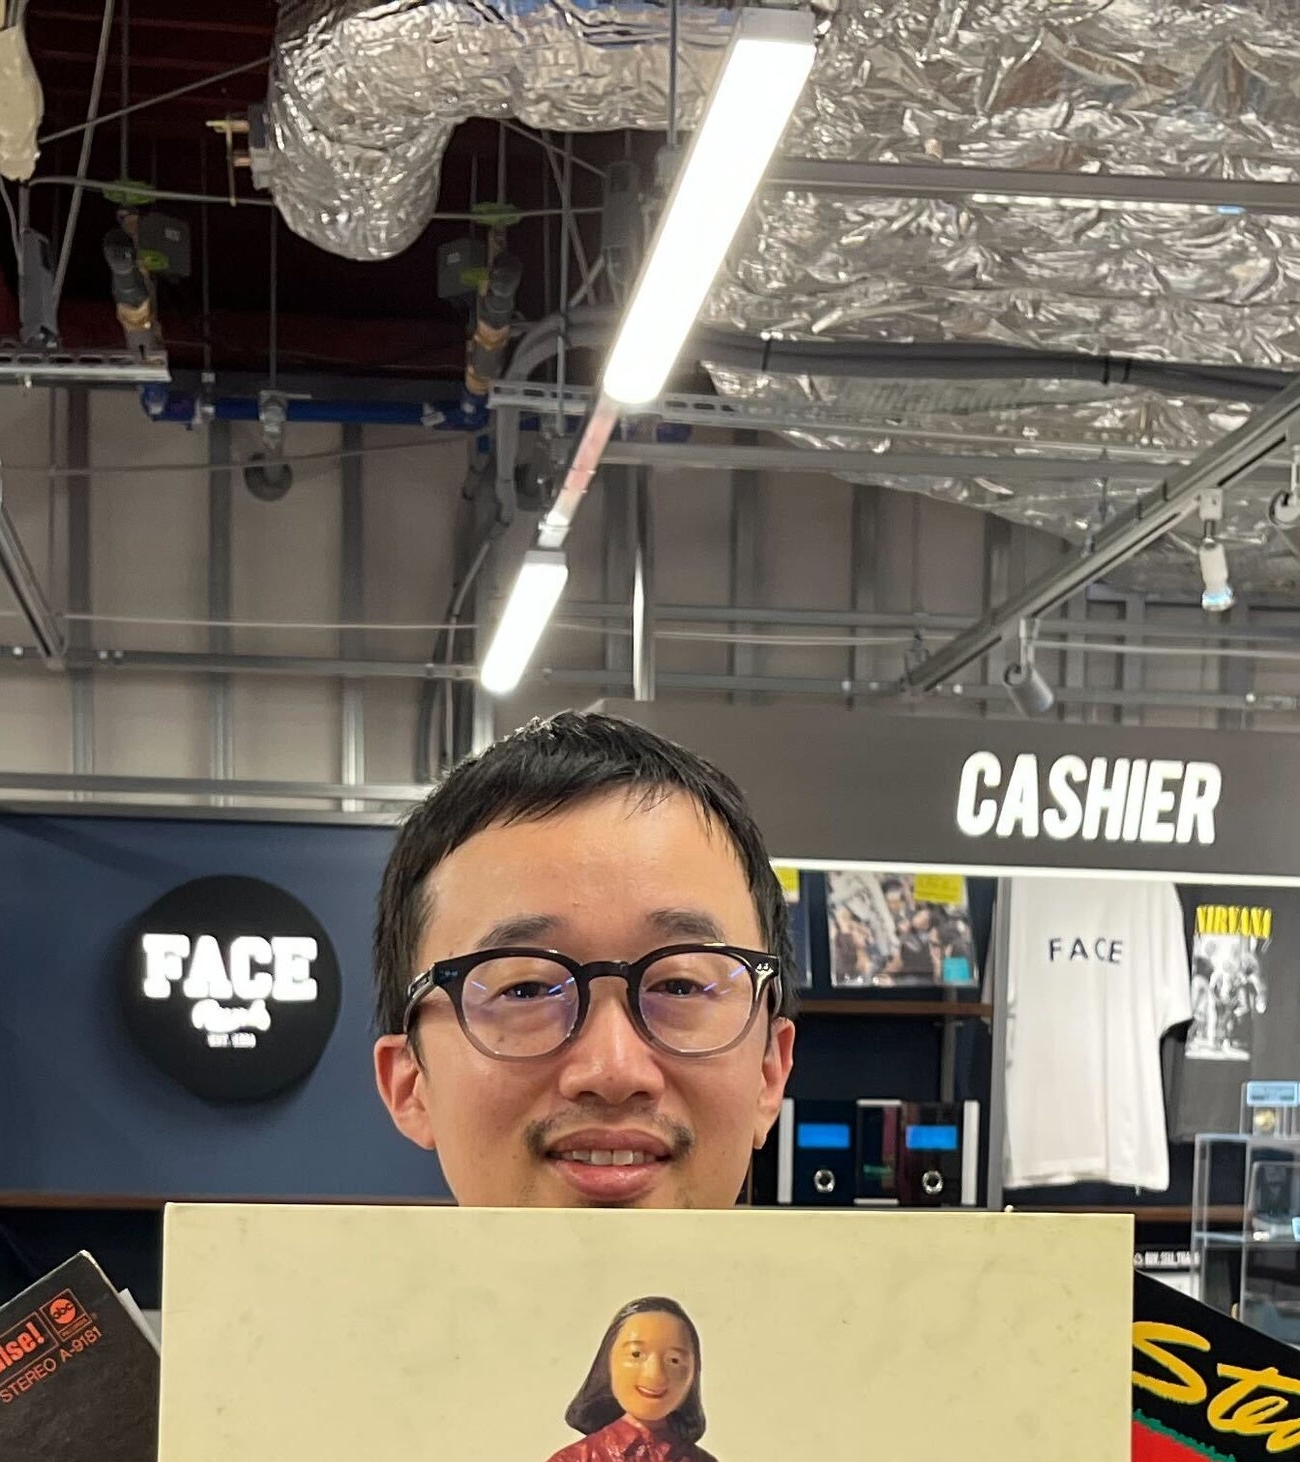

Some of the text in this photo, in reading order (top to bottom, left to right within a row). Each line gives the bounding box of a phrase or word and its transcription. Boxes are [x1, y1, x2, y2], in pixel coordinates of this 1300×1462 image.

[955, 751, 1221, 844] CASHIER
[1049, 936, 1124, 963] FACE
[1196, 905, 1271, 939] NIRVANA
[142, 934, 317, 999] FACE
[0, 1326, 103, 1402] STEREO A-9181
